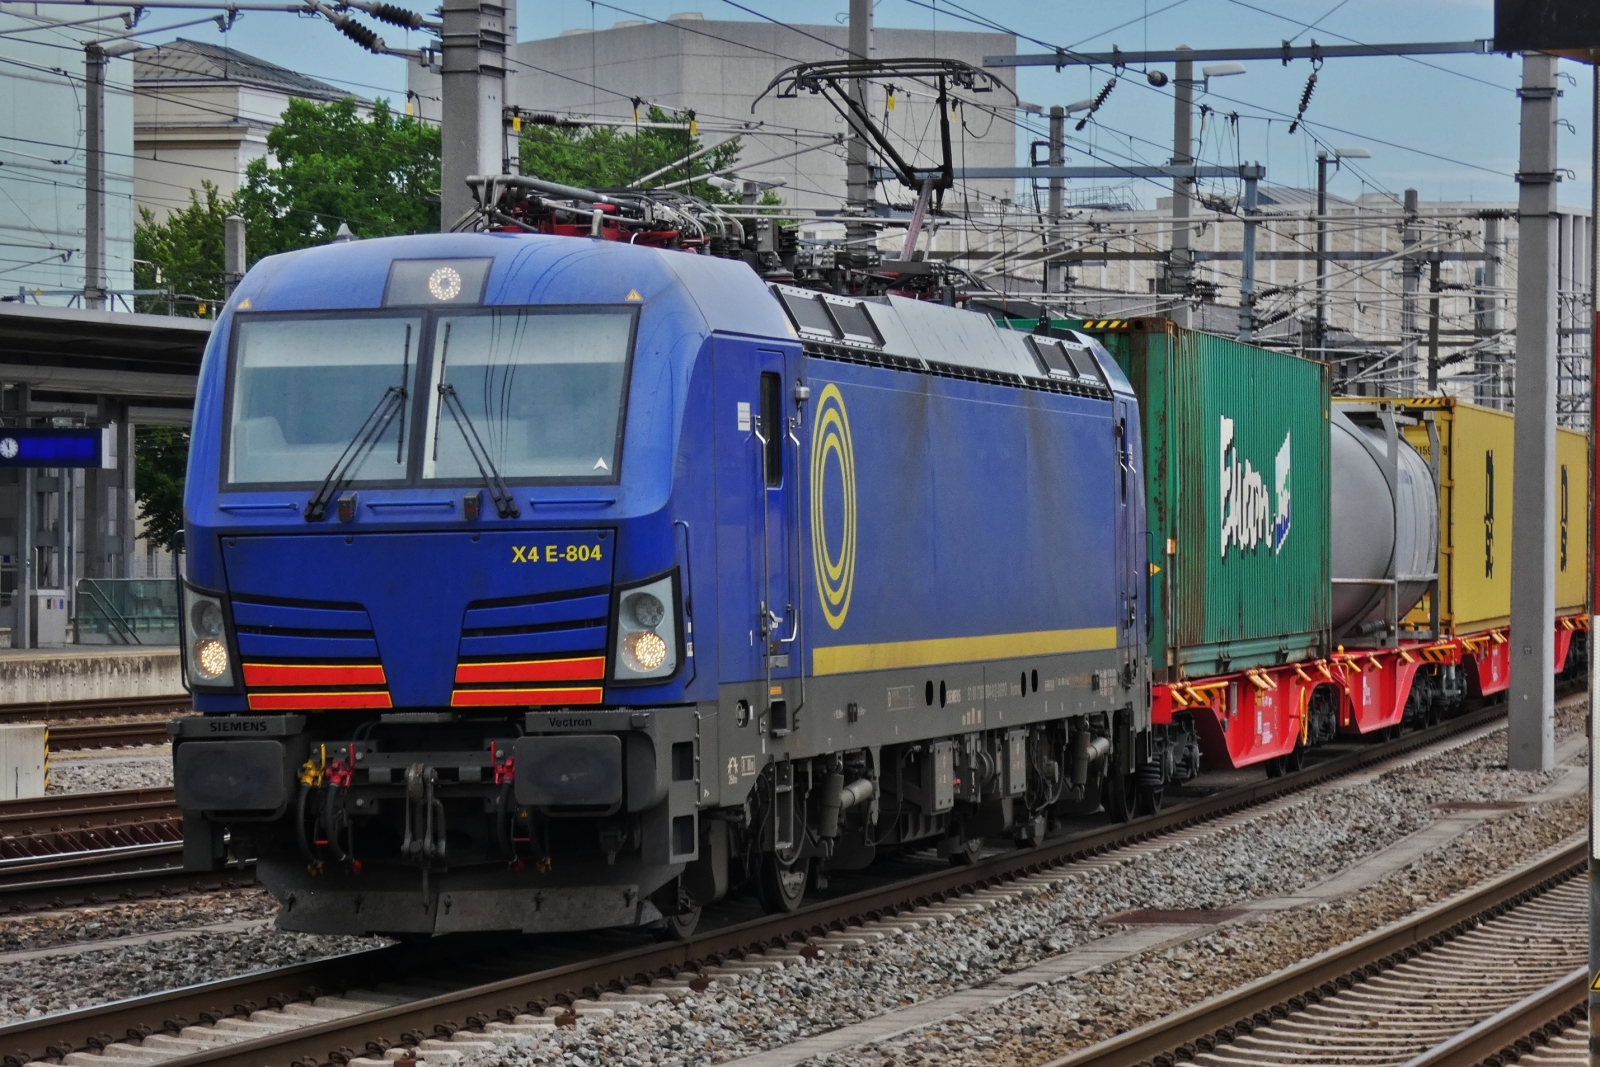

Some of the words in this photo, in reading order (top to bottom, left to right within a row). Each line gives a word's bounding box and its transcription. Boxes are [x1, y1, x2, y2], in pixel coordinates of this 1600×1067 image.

[511, 546, 540, 563] X4
[545, 544, 602, 562] E-804
[209, 721, 267, 732] SIEMENS
[548, 717, 592, 727] Vectron
